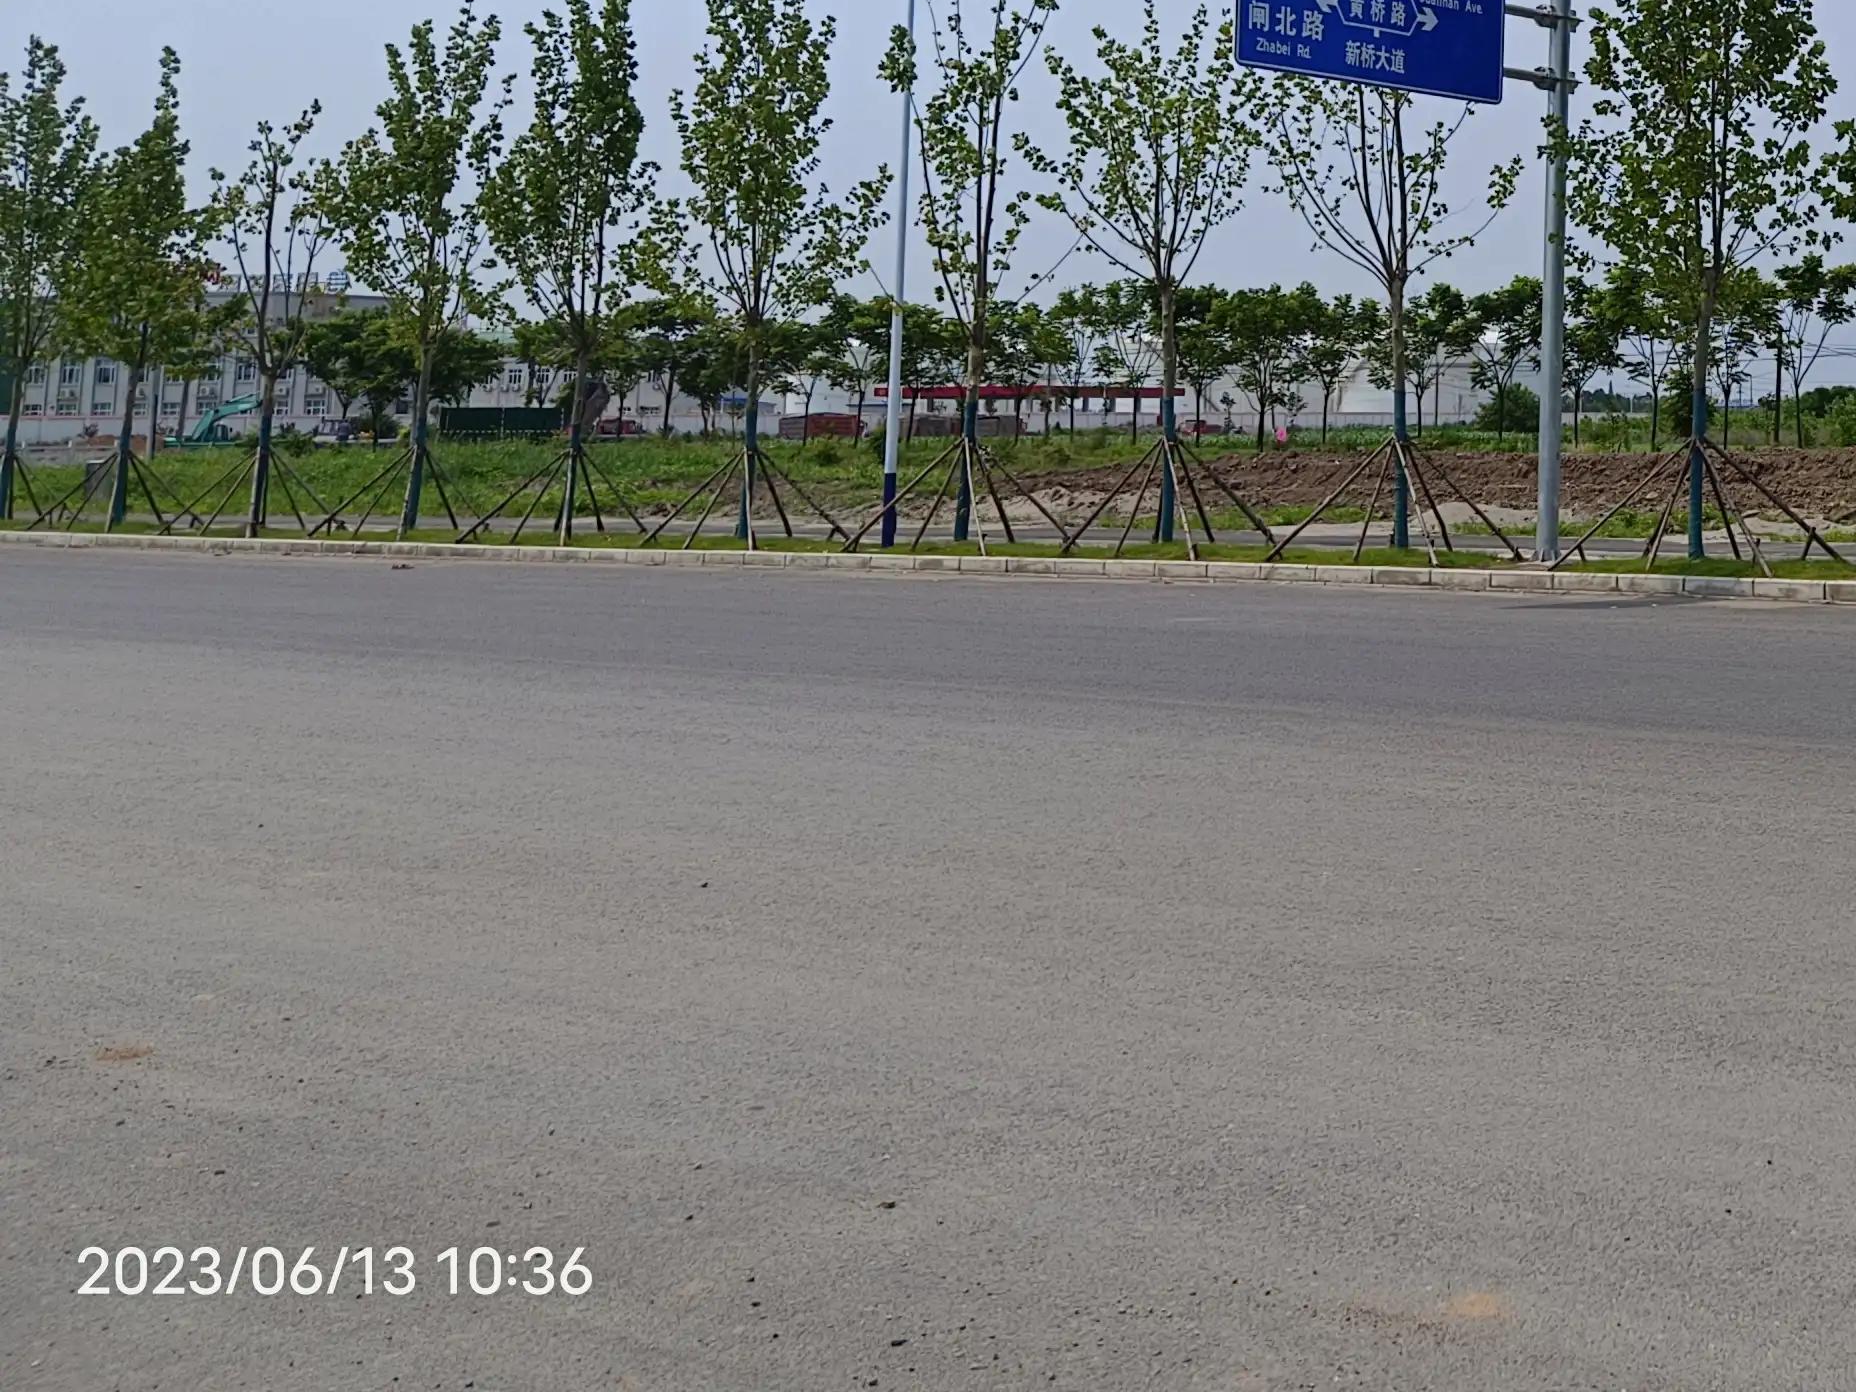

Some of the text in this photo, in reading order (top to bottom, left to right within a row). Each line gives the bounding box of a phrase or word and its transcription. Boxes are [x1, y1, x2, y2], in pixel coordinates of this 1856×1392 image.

[1255, 37, 1291, 57] Zhabei
[1344, 39, 1406, 75] 新桥大道
